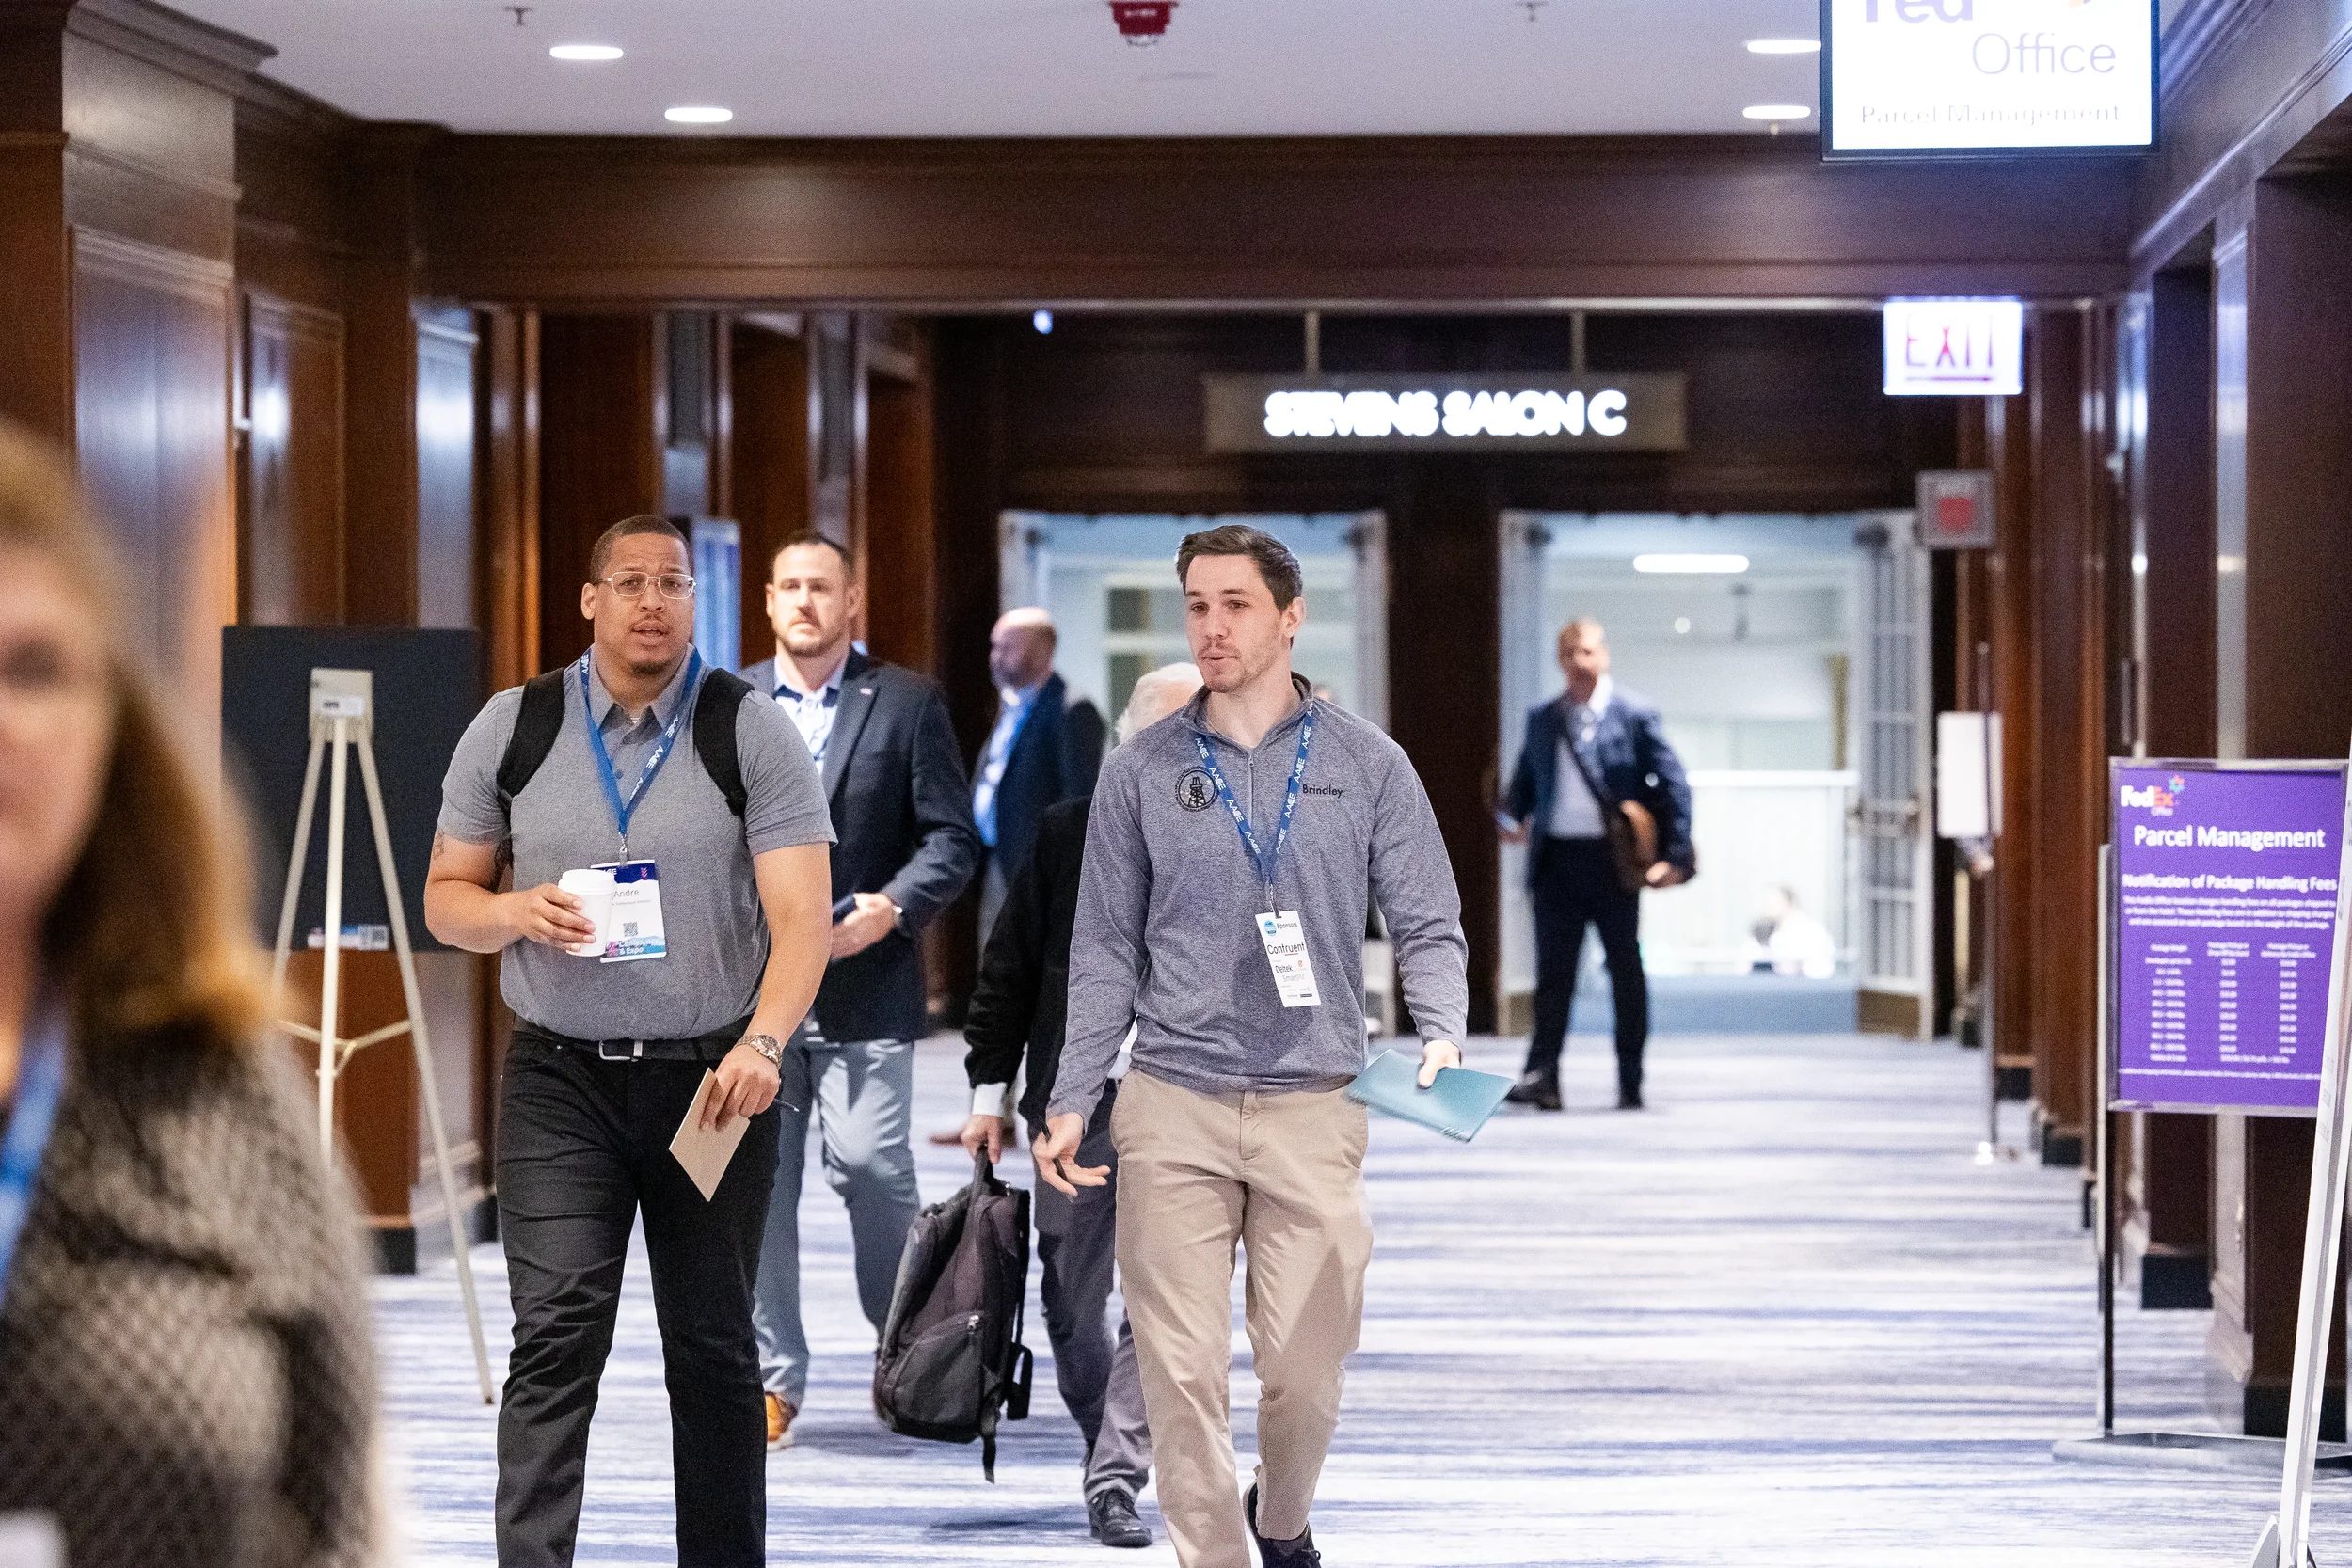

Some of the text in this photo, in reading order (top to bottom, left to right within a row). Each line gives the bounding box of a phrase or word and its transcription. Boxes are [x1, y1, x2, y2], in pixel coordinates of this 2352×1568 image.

[1972, 32, 2117, 75] Office
[1861, 104, 2121, 126] Parcel Management
[1905, 314, 1998, 368] EXIT
[1264, 389, 1628, 437] STEVENS SALON C
[1302, 784, 1343, 799] Brindley
[2121, 785, 2174, 808] FedEx
[2133, 824, 2327, 852] Parcel Management
[613, 889, 640, 897] Andre
[2191, 874, 2205, 889] of
[2206, 874, 2255, 893] Package
[2255, 875, 2309, 894] Handling
[1267, 942, 1305, 955] Contruent
